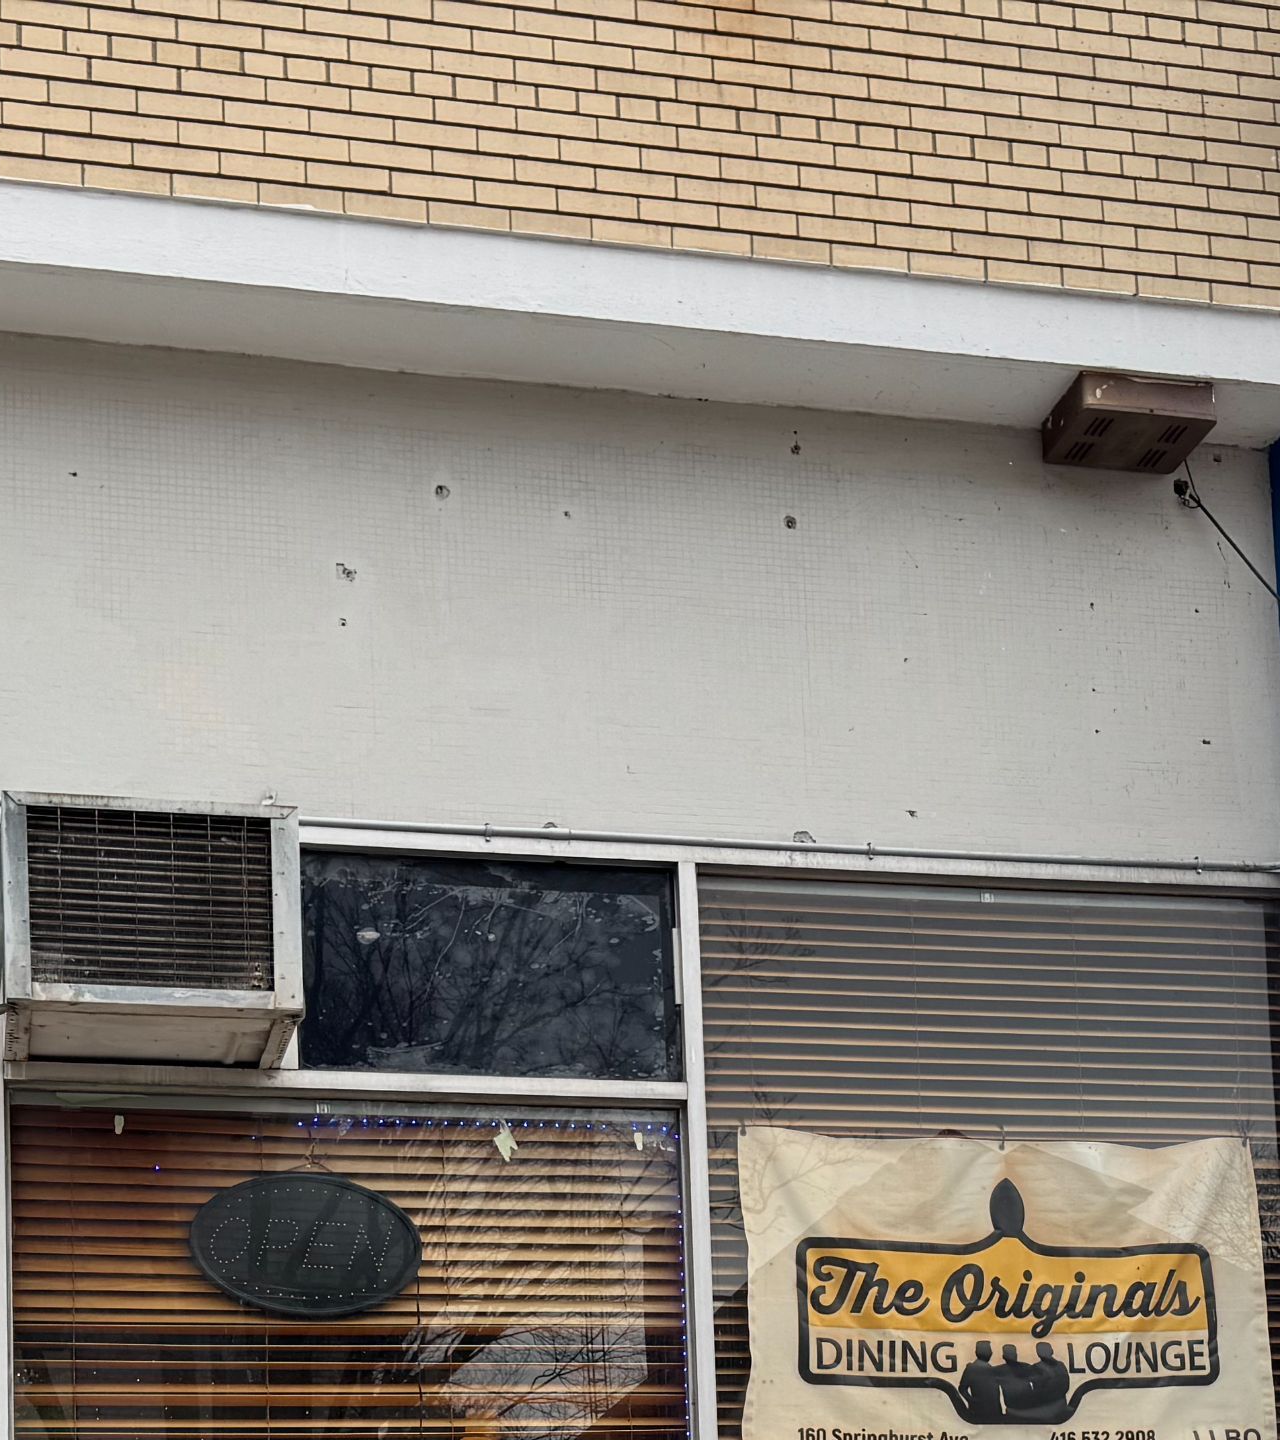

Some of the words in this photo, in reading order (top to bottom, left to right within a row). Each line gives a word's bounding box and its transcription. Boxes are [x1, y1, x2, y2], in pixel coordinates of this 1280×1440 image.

[210, 1217, 394, 1272] OPEN
[809, 1256, 930, 1317] The
[940, 1263, 1202, 1338] Originals
[815, 1336, 958, 1374] DINING
[1067, 1338, 1207, 1374] LOUNGE
